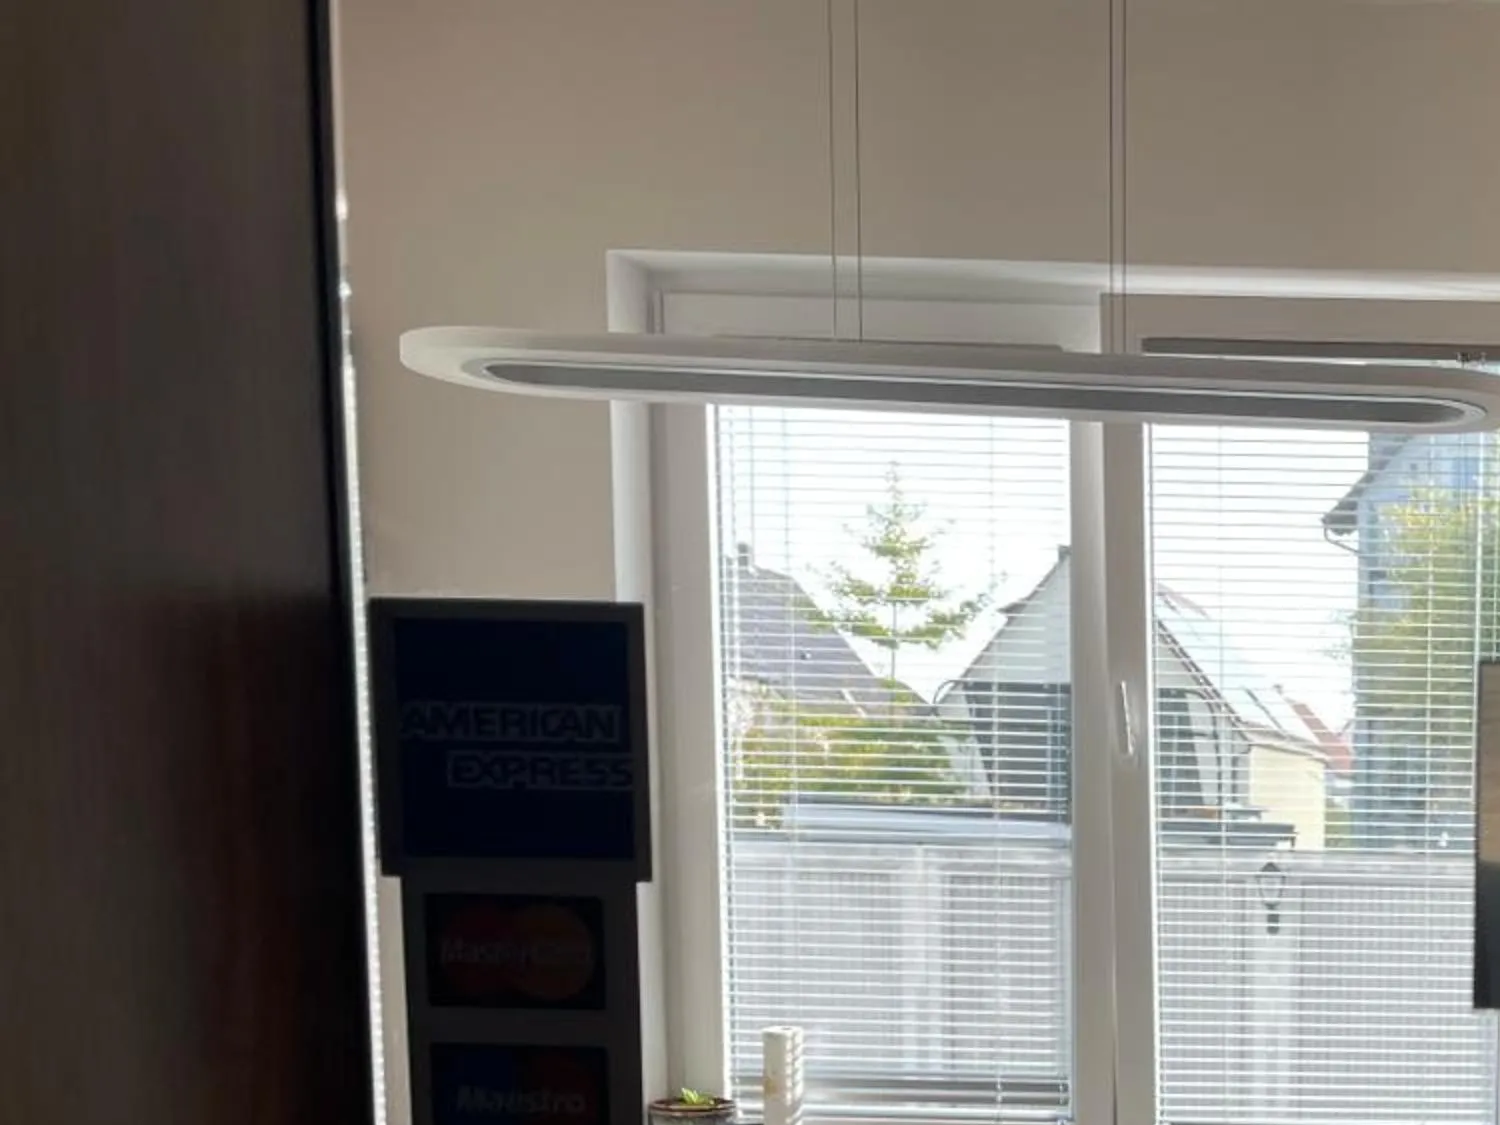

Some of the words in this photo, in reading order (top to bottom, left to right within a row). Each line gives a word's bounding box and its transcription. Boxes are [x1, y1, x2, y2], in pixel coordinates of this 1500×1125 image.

[402, 704, 621, 743] AMERICAN
[448, 754, 633, 790] EXPRESS
[456, 1083, 588, 1115] Maestro
